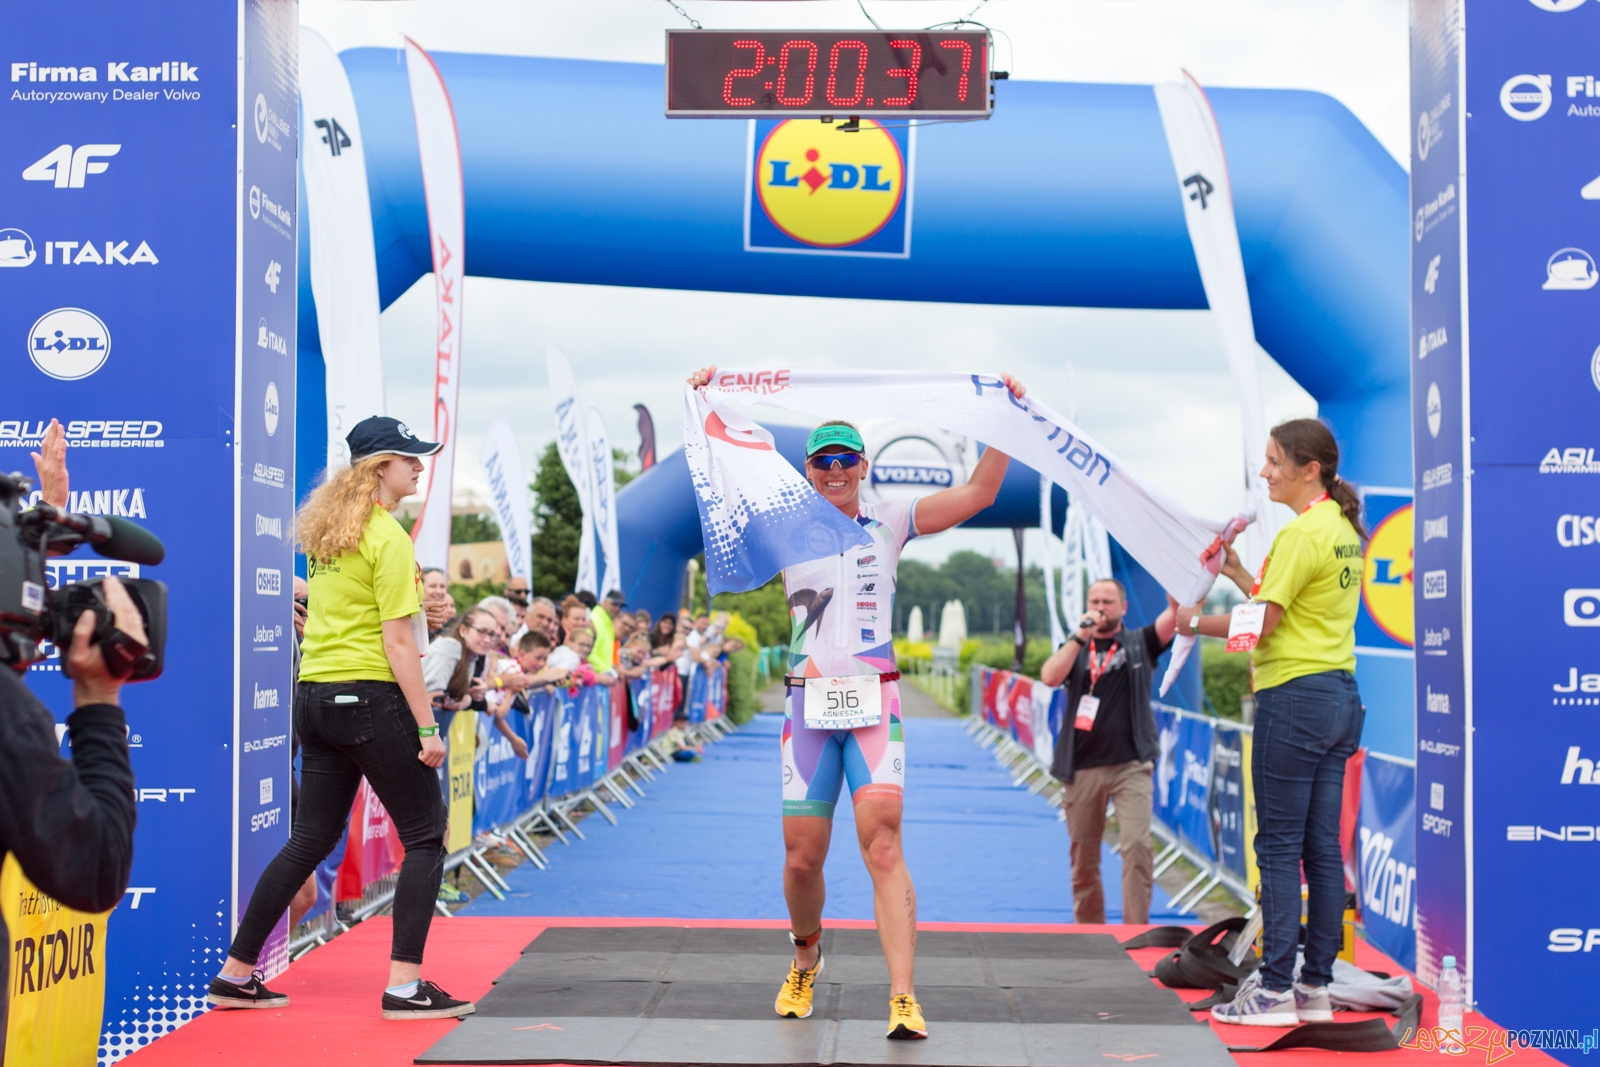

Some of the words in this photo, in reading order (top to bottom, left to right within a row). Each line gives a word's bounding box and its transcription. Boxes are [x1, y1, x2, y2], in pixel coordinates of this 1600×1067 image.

[11, 62, 97, 82] Firma
[107, 61, 199, 82] Karlik
[11, 89, 108, 104] Autoryzowany
[112, 88, 159, 101] Dealer
[163, 88, 201, 101] Volvo
[22, 144, 122, 188] 4F
[45, 240, 160, 266] ITAKA
[264, 259, 282, 294] 4F
[873, 466, 951, 486] VOLVO
[257, 571, 280, 593] OSHEE
[1425, 574, 1445, 595] OSHEE
[253, 624, 275, 643] Jabra
[1423, 627, 1443, 648] Jabra
[253, 682, 279, 709] hama
[827, 689, 860, 710] 516
[822, 709, 864, 718] AGNIESZKA
[250, 807, 282, 832] SPORT
[1422, 812, 1453, 838] SPORT
[14, 922, 95, 998] TRITOUR
